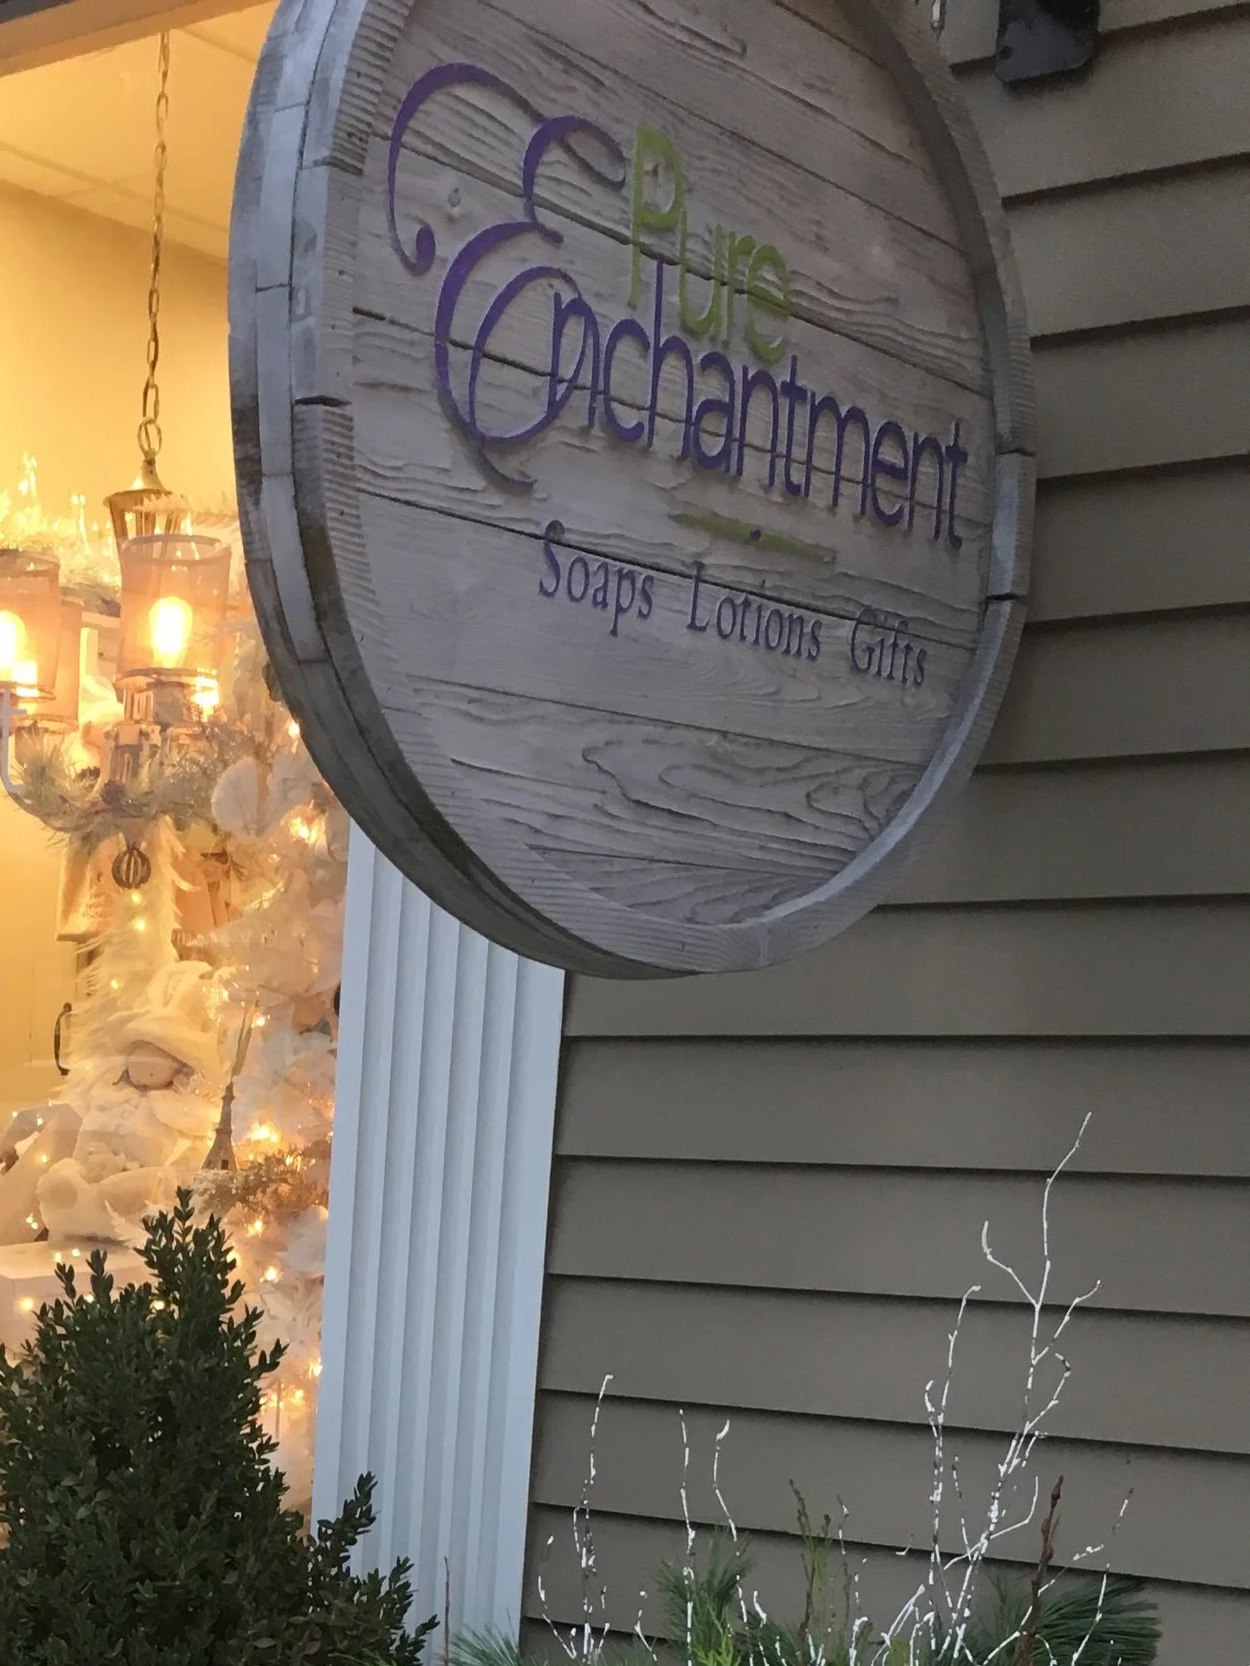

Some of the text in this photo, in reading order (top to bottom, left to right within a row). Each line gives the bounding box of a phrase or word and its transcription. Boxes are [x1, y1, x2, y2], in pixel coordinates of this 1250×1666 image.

[387, 60, 969, 551] Enchantment
[627, 123, 791, 365] Pure
[537, 518, 928, 689] Soaps Lotions Gifts
